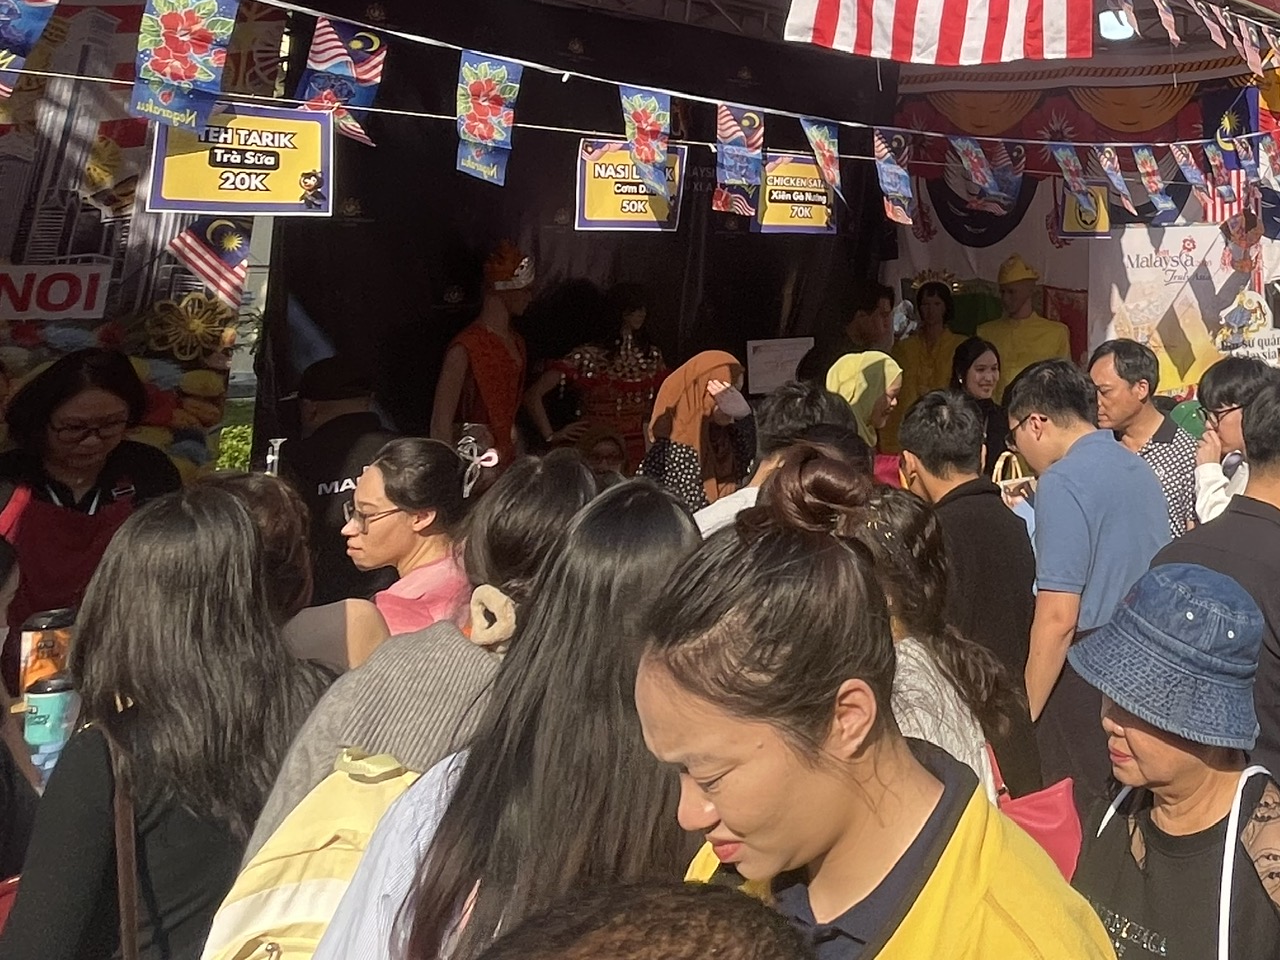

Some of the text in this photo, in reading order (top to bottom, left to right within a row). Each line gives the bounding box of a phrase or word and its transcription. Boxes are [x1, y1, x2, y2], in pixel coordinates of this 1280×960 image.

[200, 126, 296, 149] TEH TARIK
[213, 149, 276, 166] Trà Sữa
[594, 164, 632, 179] NASI
[219, 172, 268, 191] 20K
[614, 183, 638, 194] Cơm
[766, 176, 825, 189] CHICKEN SAT
[621, 200, 647, 213] 50K
[790, 206, 812, 218] 70K
[1127, 253, 1195, 272] Malaysia
[318, 477, 360, 496] MA
